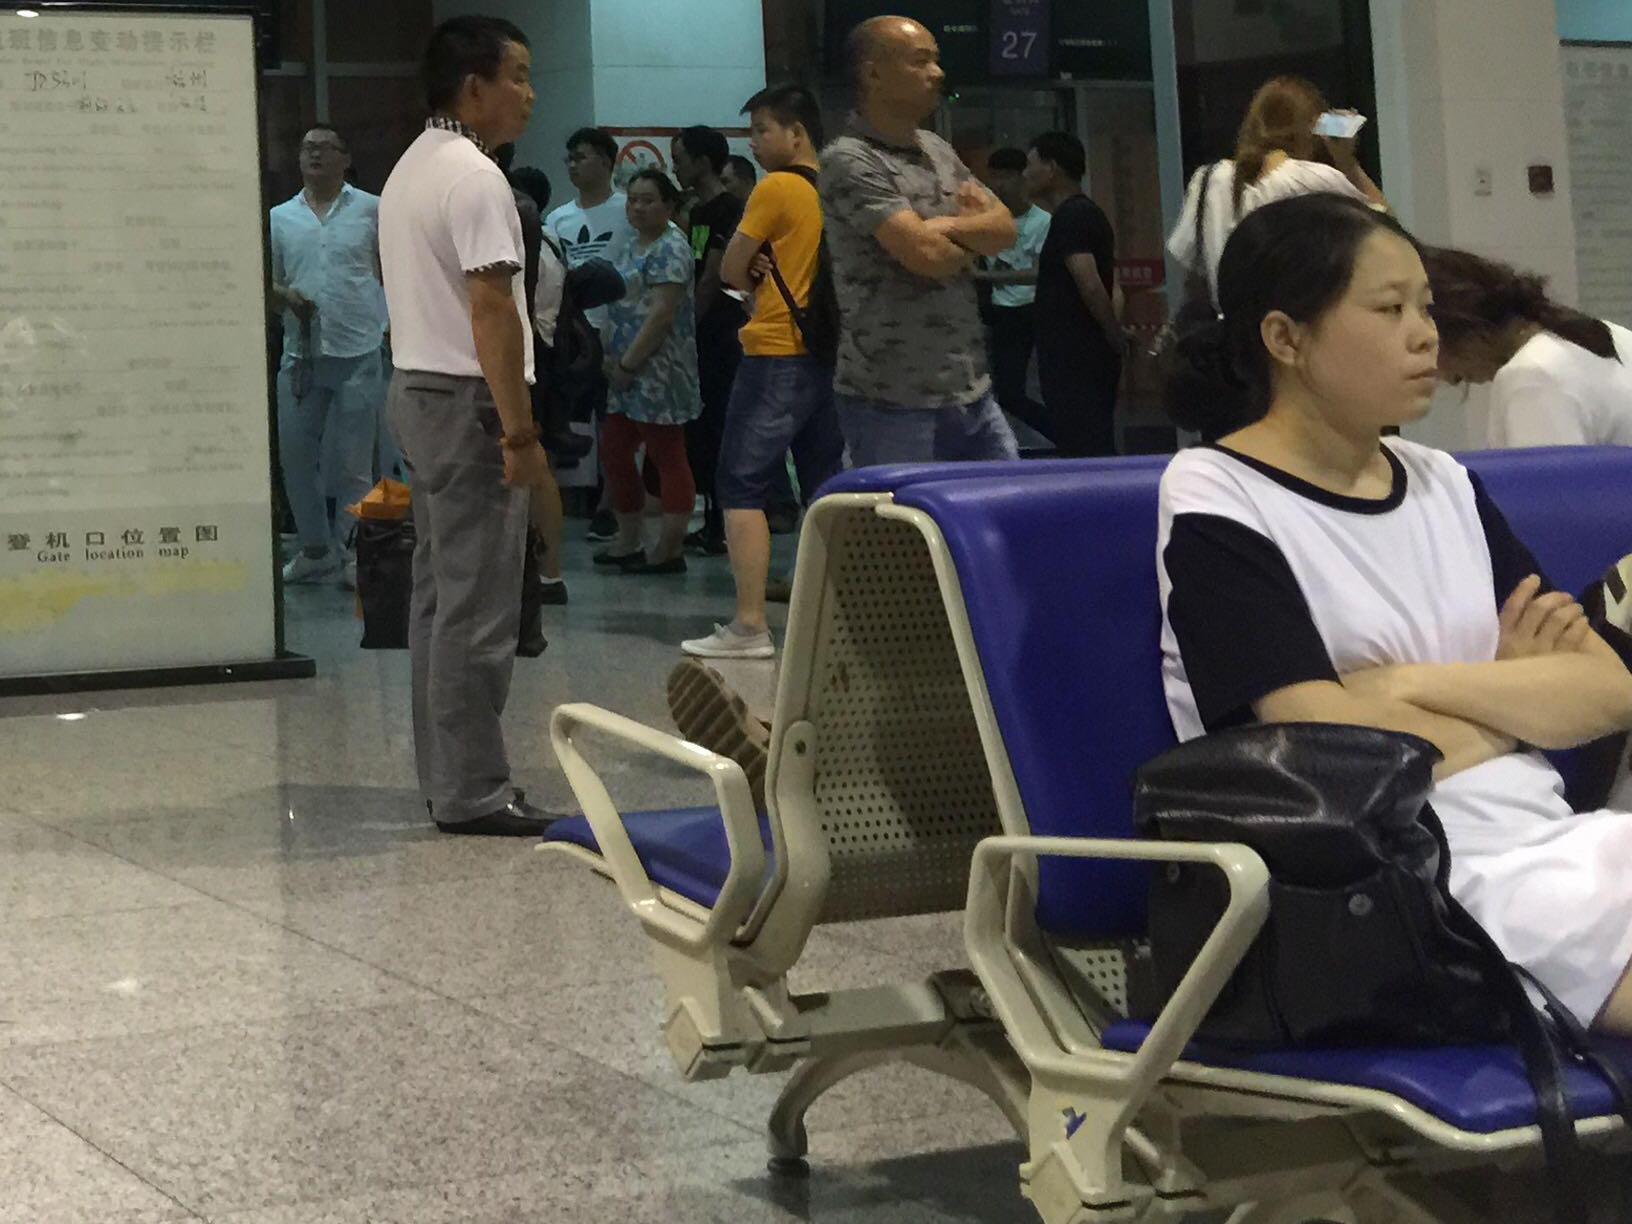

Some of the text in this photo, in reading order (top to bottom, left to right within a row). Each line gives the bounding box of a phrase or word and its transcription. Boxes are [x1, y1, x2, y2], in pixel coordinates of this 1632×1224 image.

[1001, 31, 1038, 60] 27
[7, 524, 218, 551] 登机口位置图
[37, 546, 190, 562] Gate location map
